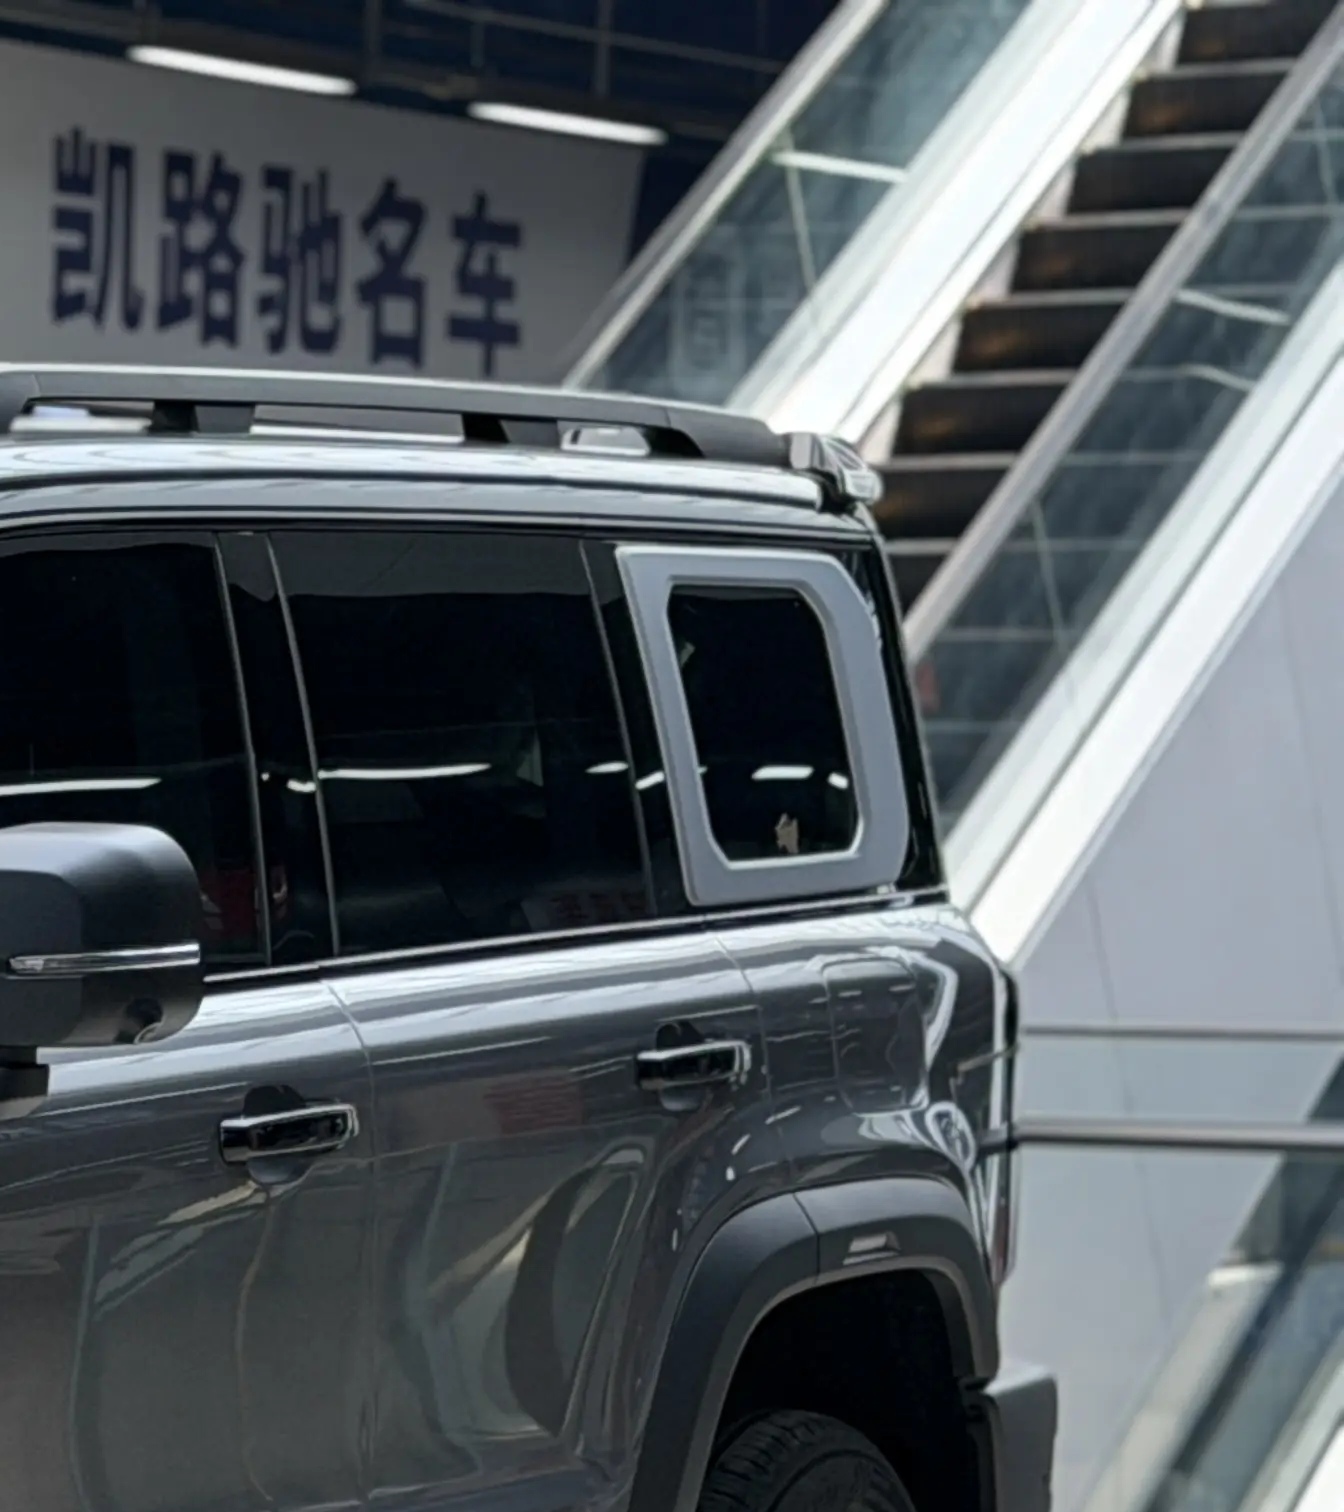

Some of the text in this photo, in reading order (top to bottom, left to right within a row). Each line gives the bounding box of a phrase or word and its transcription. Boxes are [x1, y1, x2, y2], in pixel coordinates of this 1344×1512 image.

[49, 126, 522, 376] 凯路驰名车
